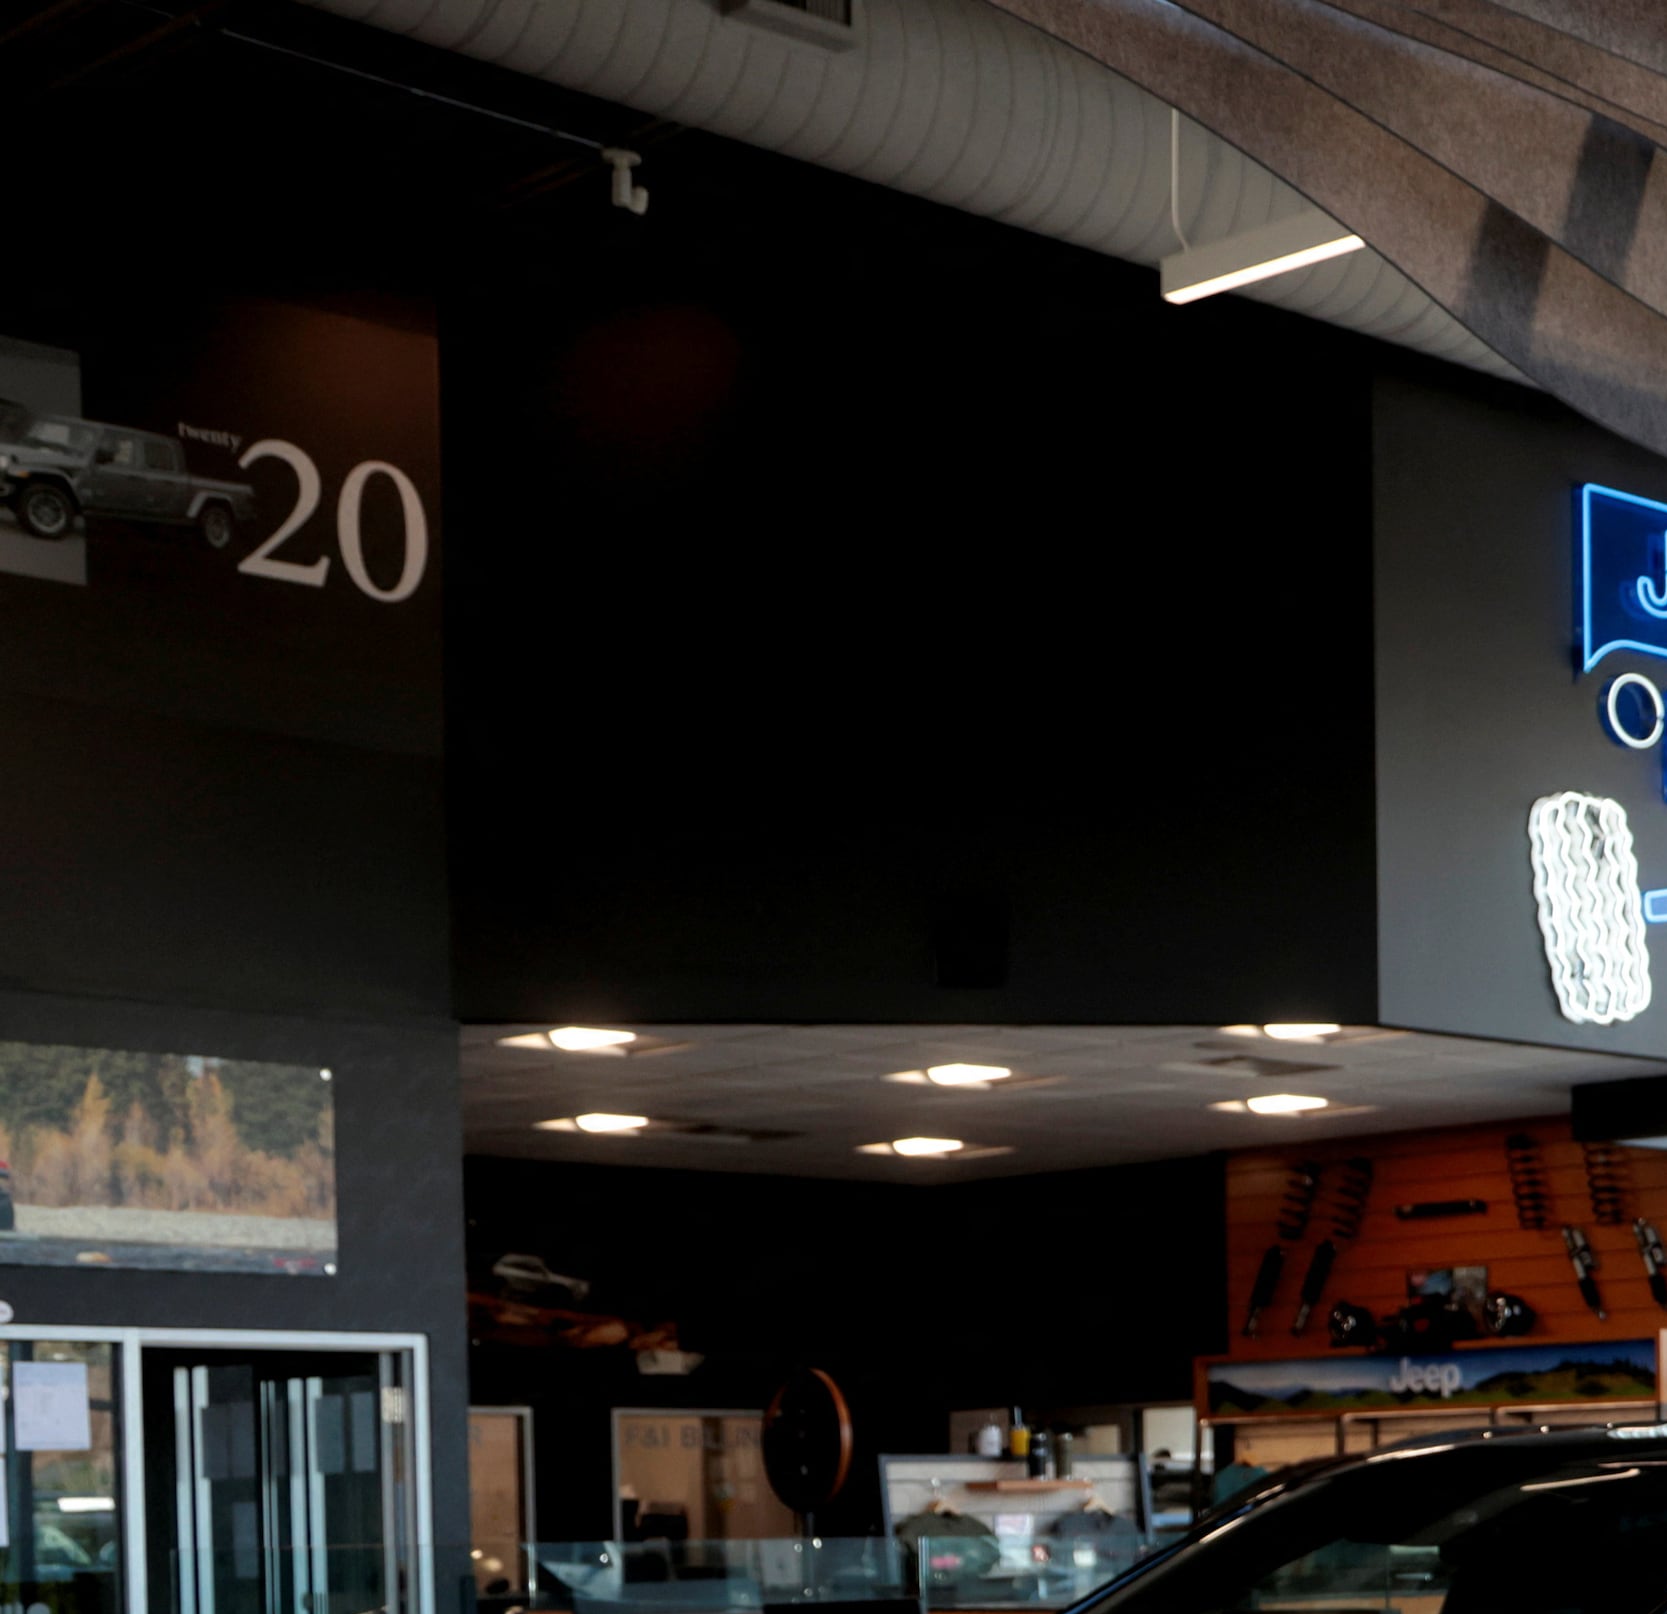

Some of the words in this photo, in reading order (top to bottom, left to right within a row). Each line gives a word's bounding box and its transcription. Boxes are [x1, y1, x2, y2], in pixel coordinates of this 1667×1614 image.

[178, 421, 242, 454] twenty
[237, 438, 428, 602] 20
[1388, 1356, 1463, 1399] Jeep
[681, 1424, 762, 1450] BILLIN
